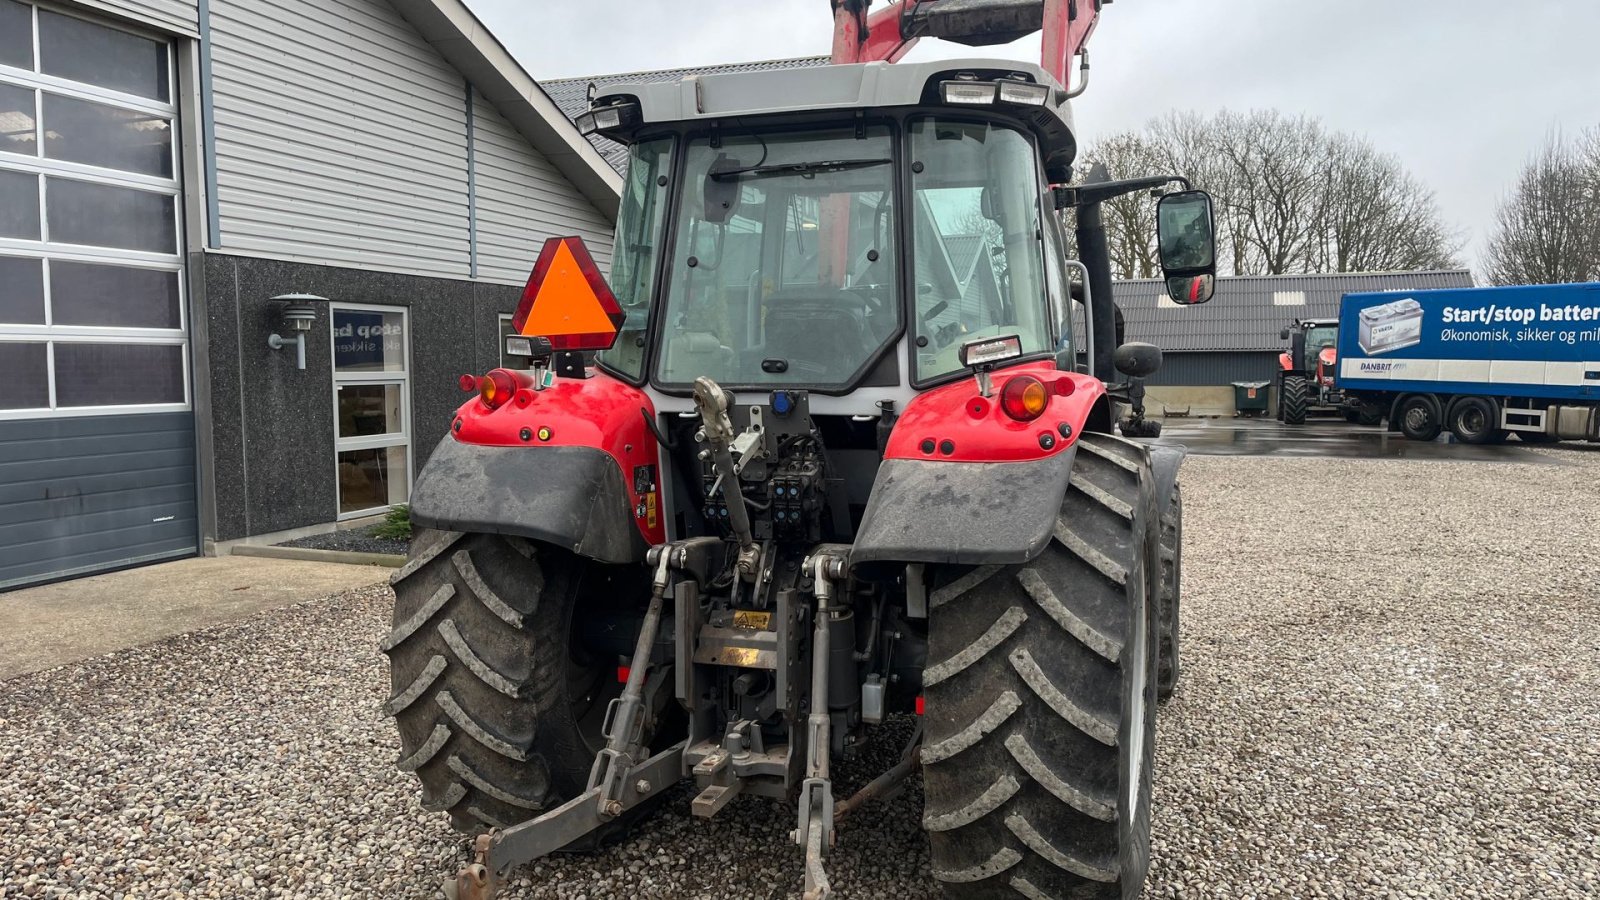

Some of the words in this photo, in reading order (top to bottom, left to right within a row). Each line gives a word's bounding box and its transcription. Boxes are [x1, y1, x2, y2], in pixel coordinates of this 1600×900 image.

[1442, 304, 1536, 325] Start/stop
[1540, 303, 1600, 321] batter
[1441, 327, 1512, 343] Økonomisk,
[1516, 327, 1556, 341] sikker
[1559, 330, 1576, 344] og
[1360, 362, 1392, 371] DANBRIT
